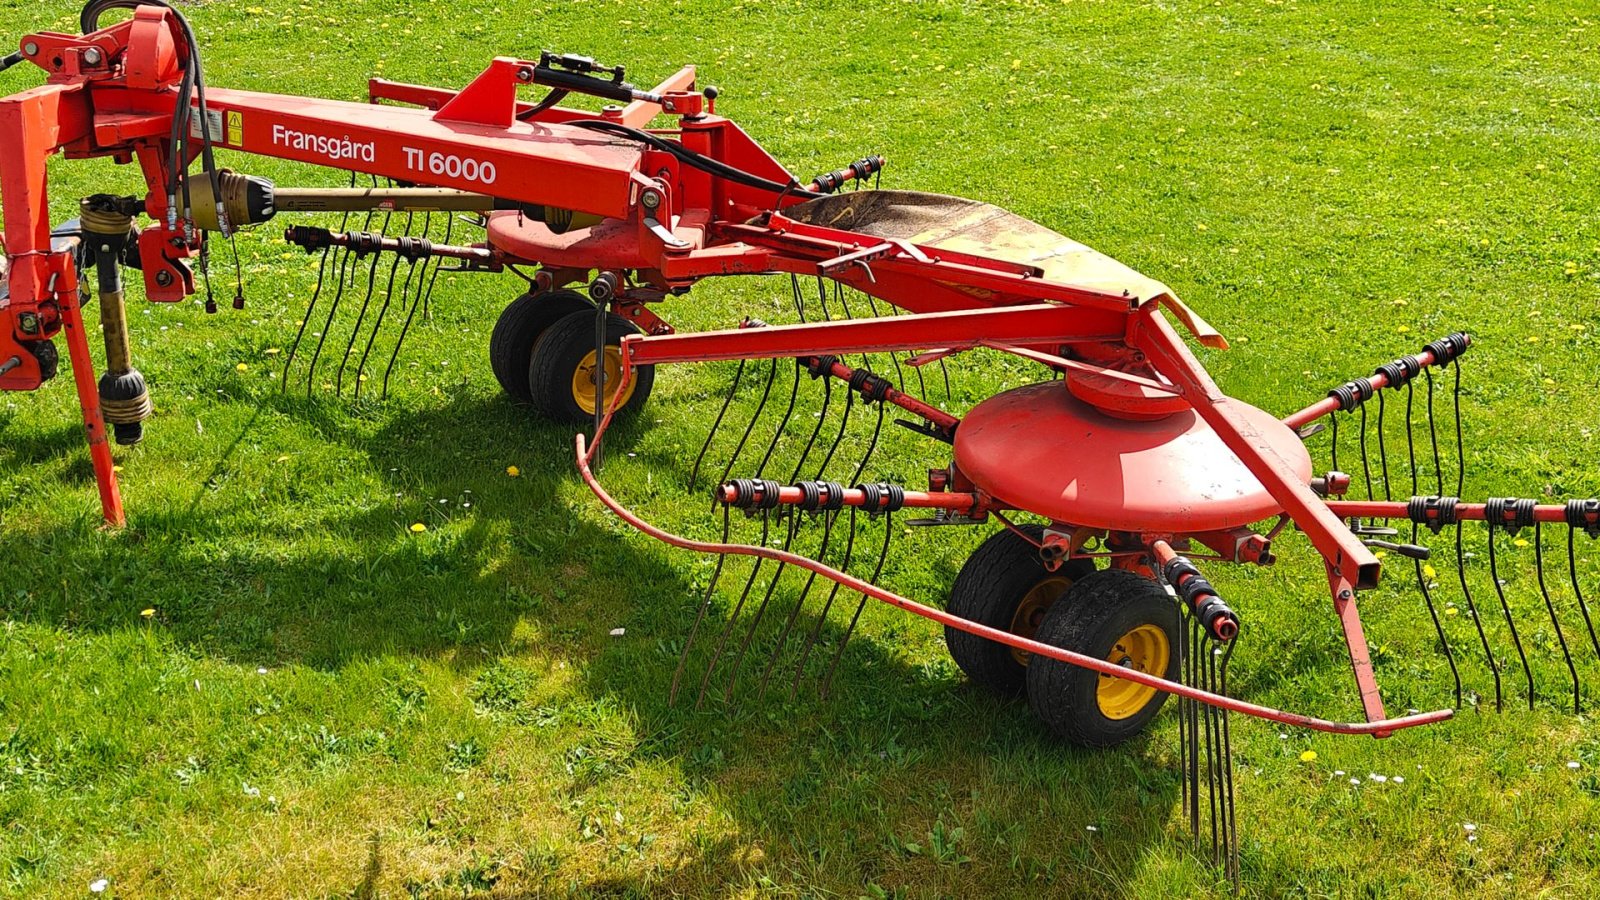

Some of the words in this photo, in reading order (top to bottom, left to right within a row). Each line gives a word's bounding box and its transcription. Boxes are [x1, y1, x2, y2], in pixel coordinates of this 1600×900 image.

[272, 124, 375, 162] Fransgård
[402, 146, 424, 171] TI
[429, 152, 496, 184] 6000
